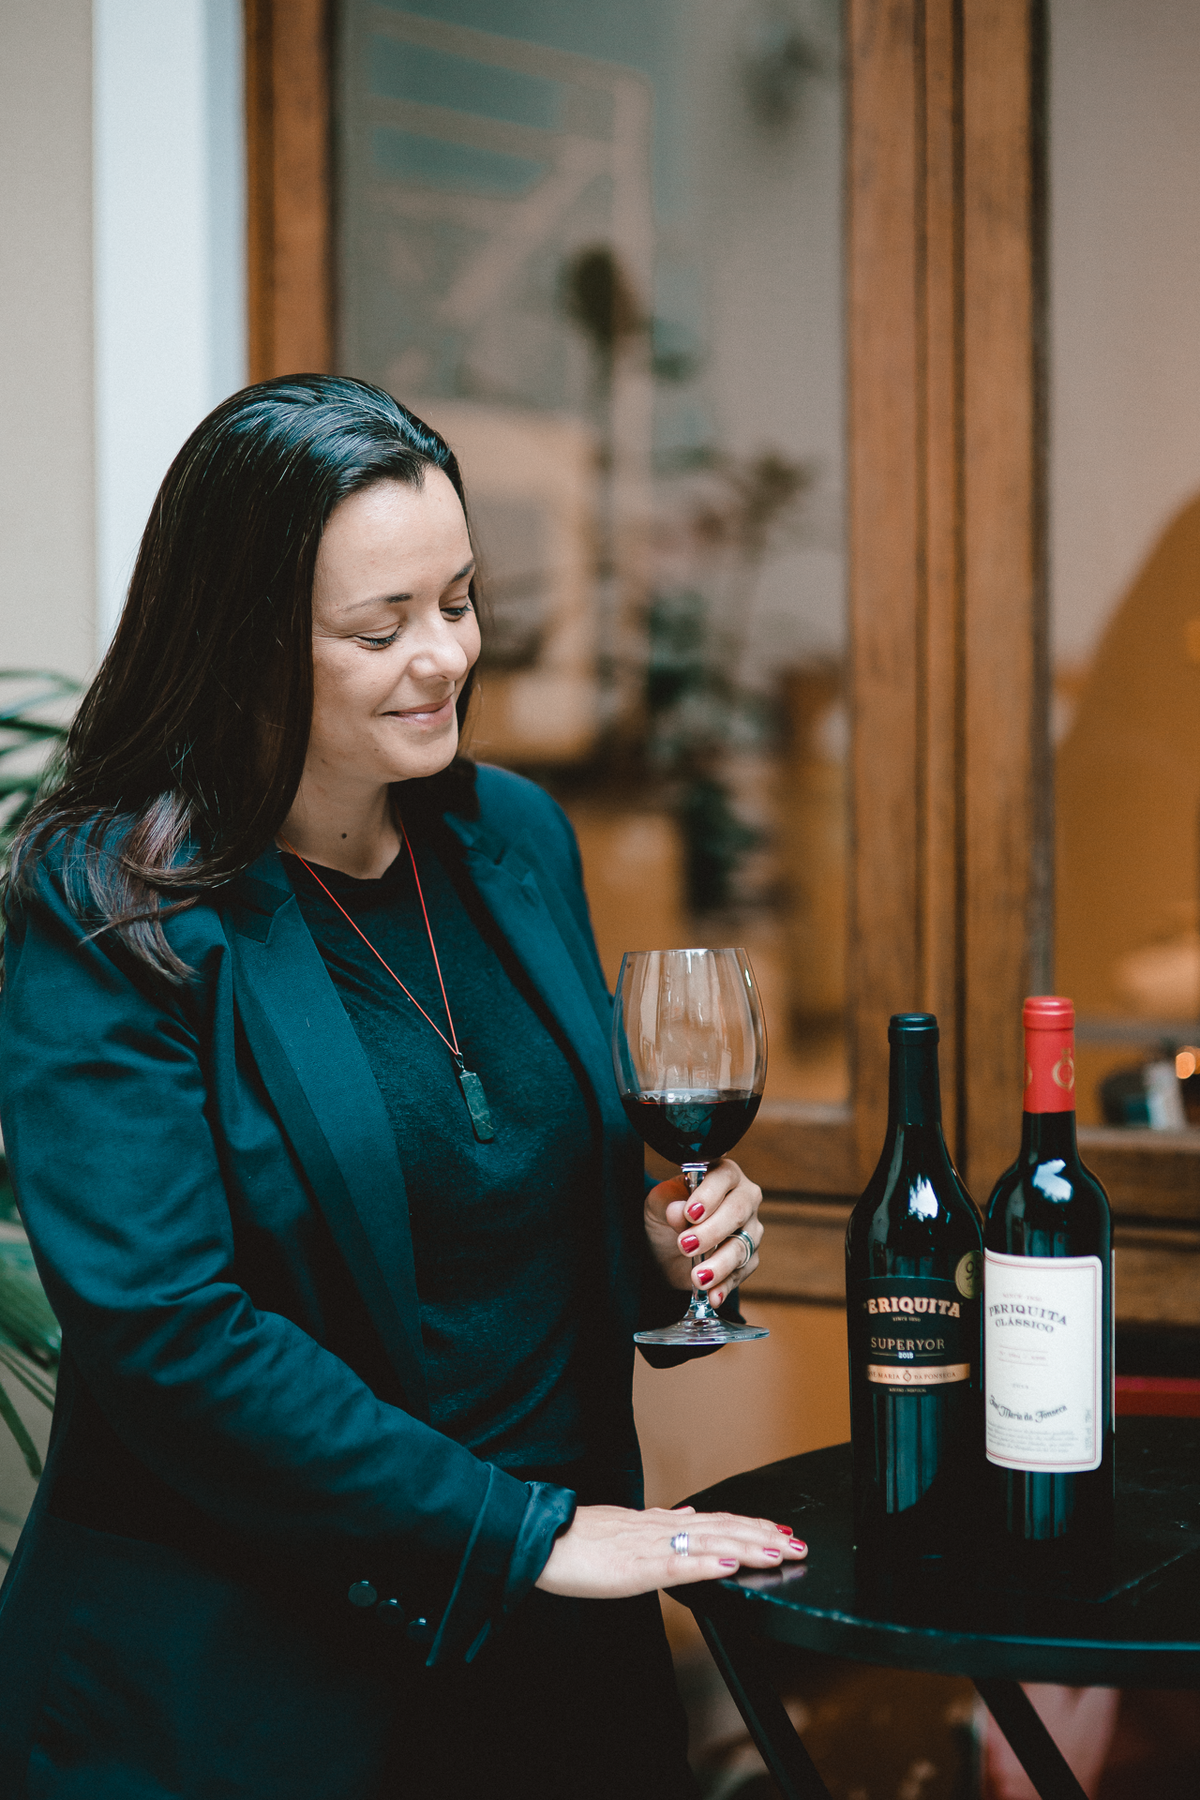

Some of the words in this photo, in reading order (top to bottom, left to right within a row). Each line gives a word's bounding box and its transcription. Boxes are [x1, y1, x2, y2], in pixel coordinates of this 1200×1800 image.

[863, 1296, 961, 1319] ERIQUITA
[989, 1303, 1067, 1326] PERIQUITA
[870, 1337, 945, 1350] SUPERYOR
[878, 1372, 900, 1380] MARIA
[924, 1371, 957, 1380] FONSECA
[999, 1404, 1023, 1421] Maria
[1024, 1412, 1033, 1421] da
[1035, 1404, 1068, 1423] Fonseca
